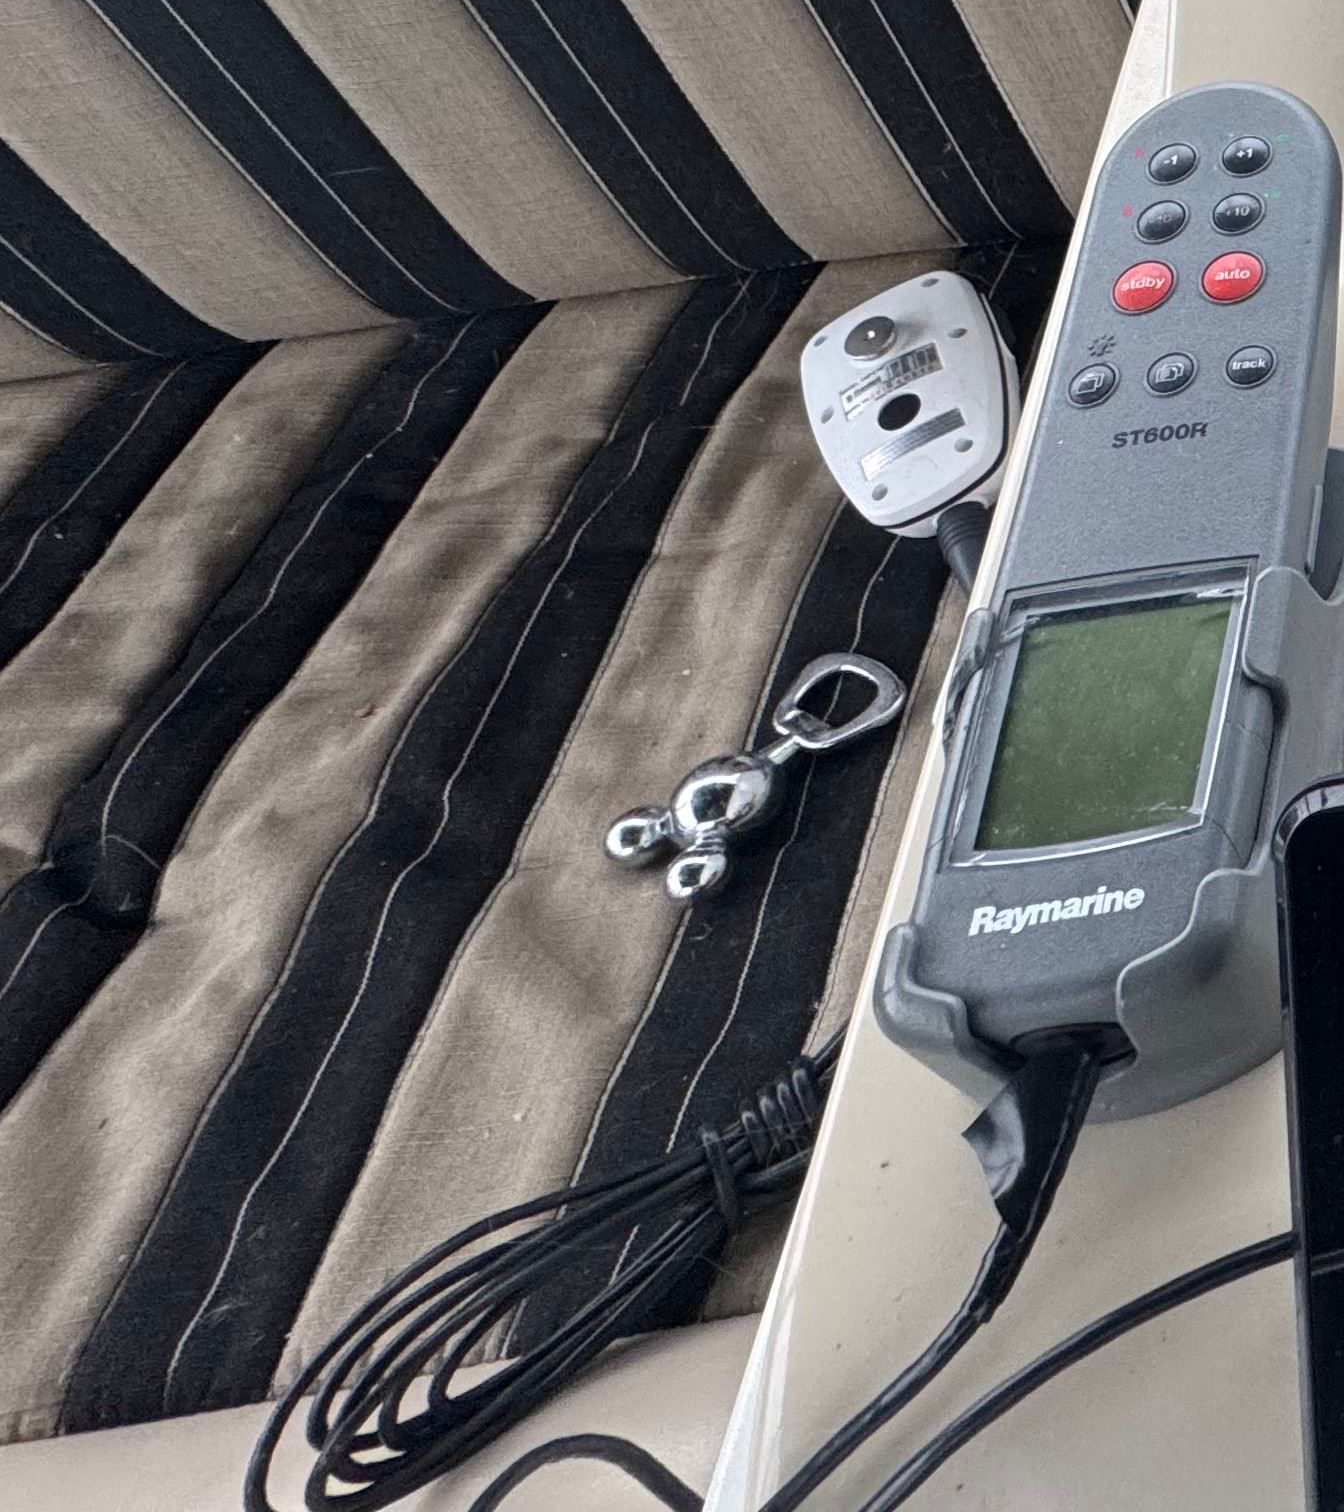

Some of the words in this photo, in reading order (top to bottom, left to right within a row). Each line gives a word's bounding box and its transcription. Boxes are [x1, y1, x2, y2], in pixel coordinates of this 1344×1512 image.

[1163, 154, 1179, 166] -1
[1236, 147, 1254, 159] +1
[1214, 268, 1251, 281] auto
[1120, 275, 1167, 292] stdby
[1231, 357, 1267, 371] track
[1111, 421, 1209, 449] ST600R
[968, 885, 1146, 937] Raymarine
